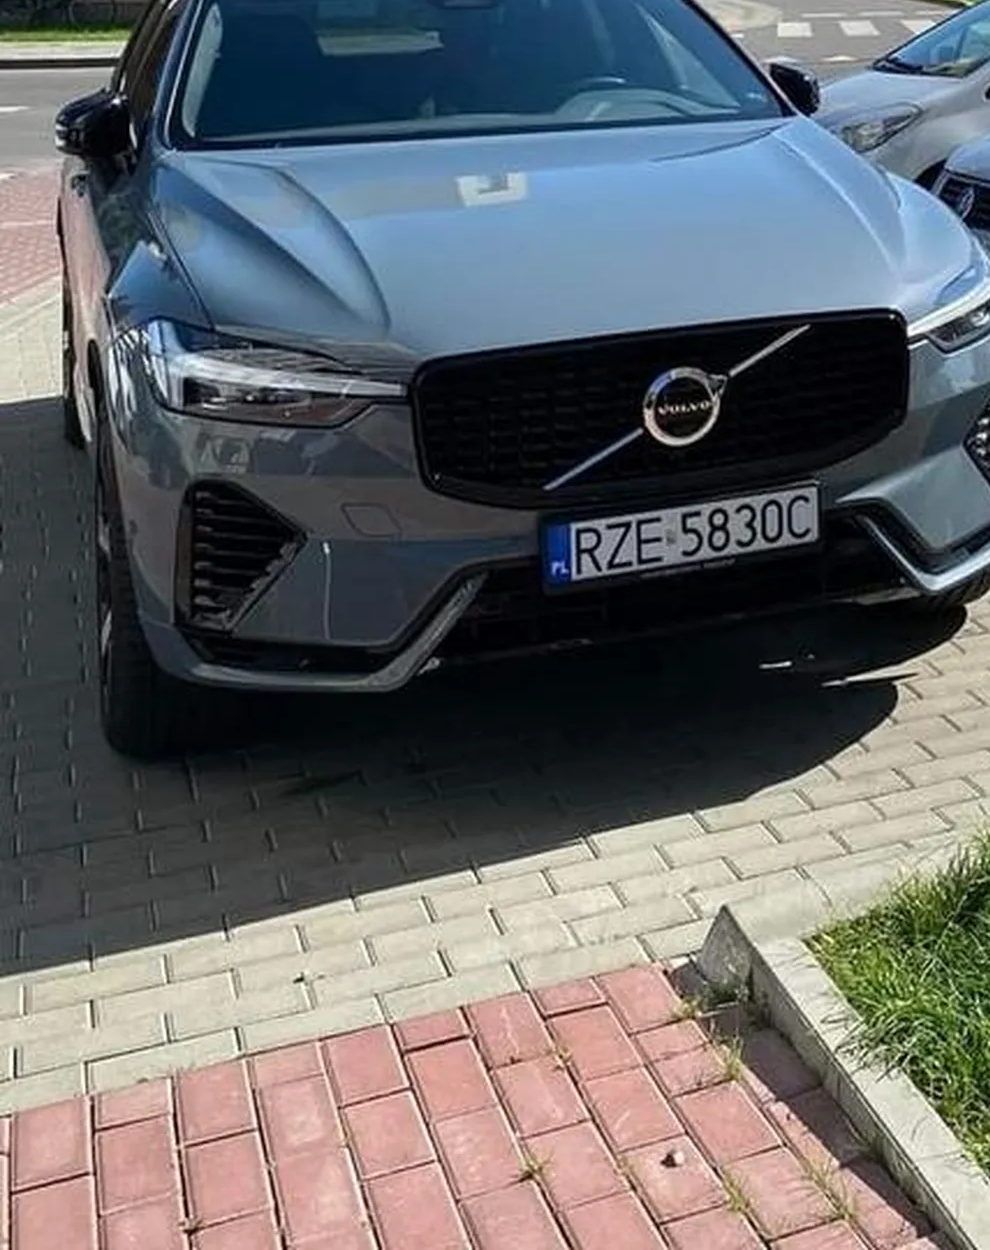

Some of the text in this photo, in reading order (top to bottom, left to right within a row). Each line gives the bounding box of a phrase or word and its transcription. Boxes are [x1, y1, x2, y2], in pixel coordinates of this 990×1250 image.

[658, 399, 711, 415] VOLVO
[574, 494, 812, 575] RZE 5830C
